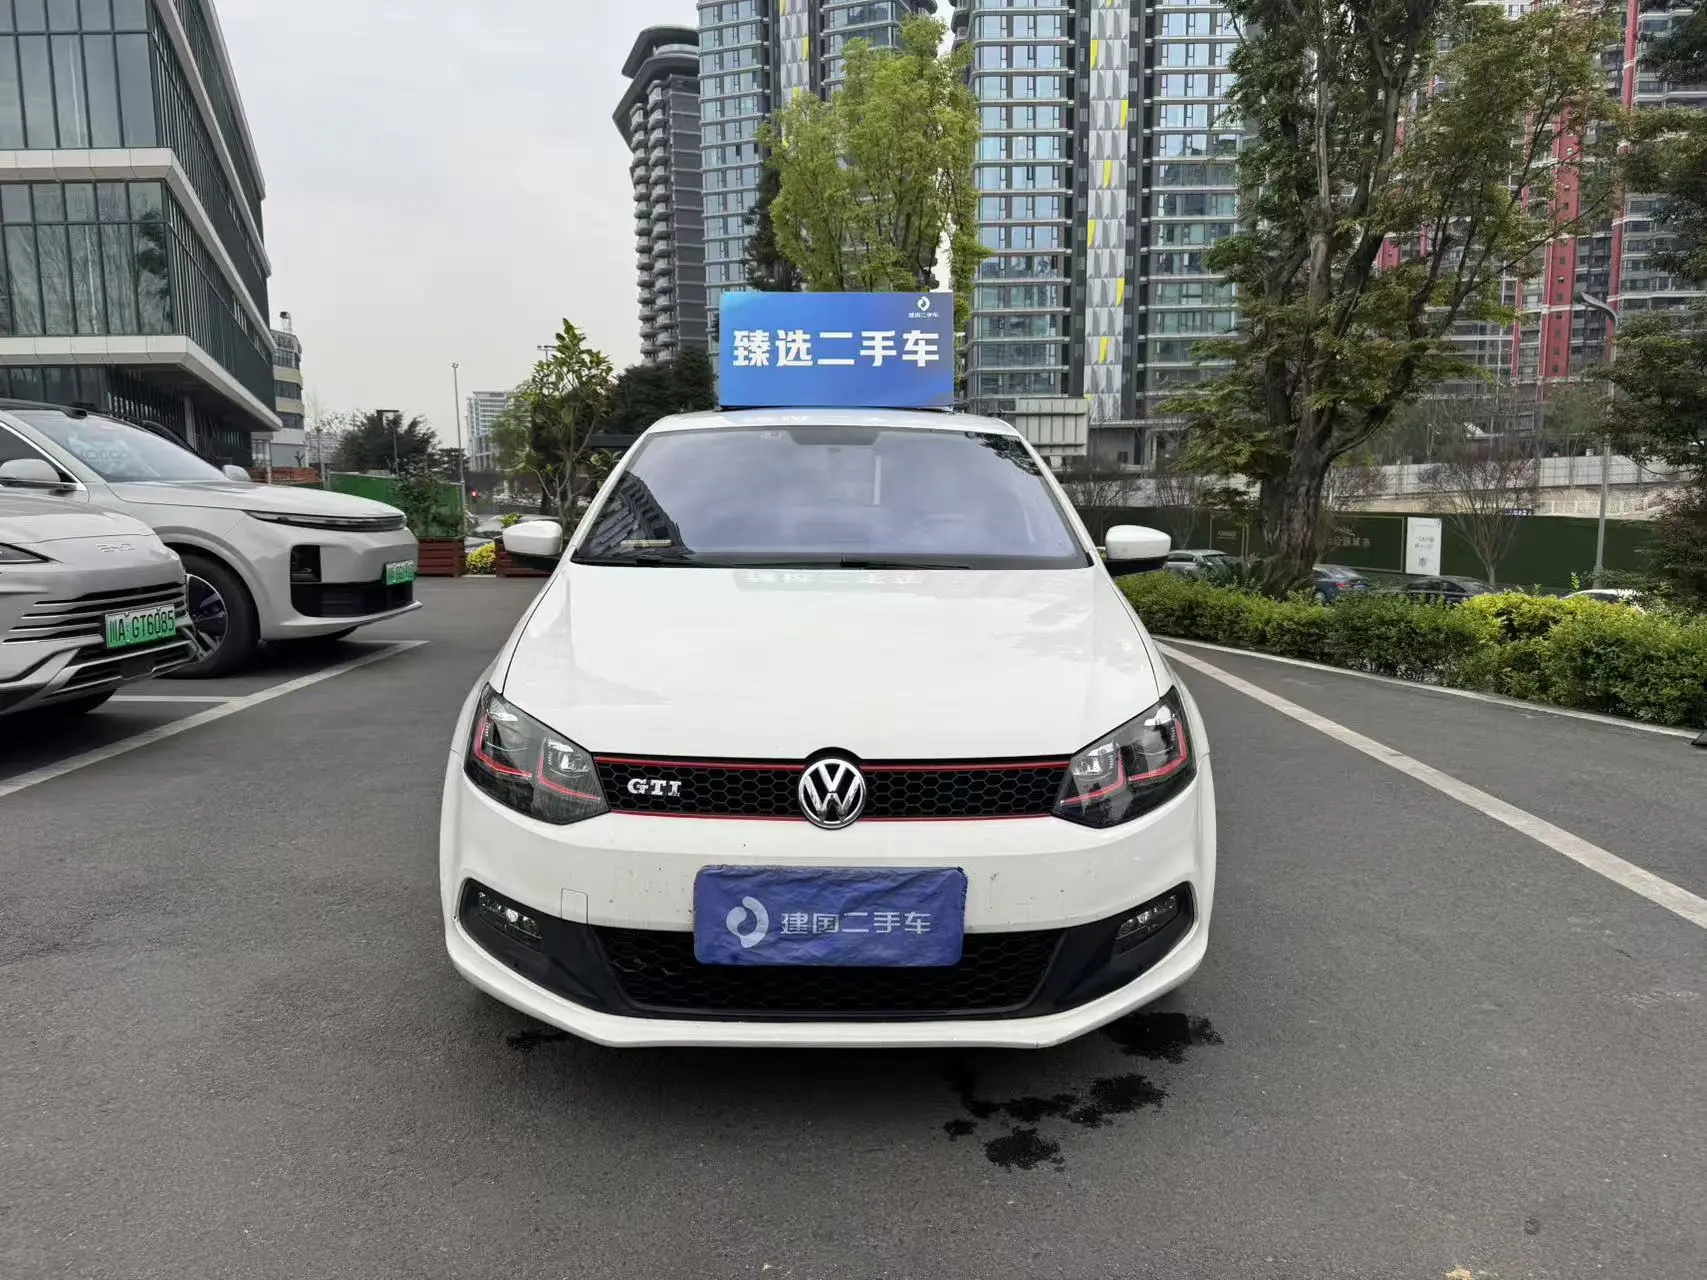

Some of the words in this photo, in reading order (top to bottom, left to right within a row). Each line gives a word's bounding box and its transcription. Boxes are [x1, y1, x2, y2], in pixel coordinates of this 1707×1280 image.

[732, 329, 940, 367] 臻选二手车
[627, 778, 682, 797] GTI
[780, 911, 931, 936] 建国二手车
